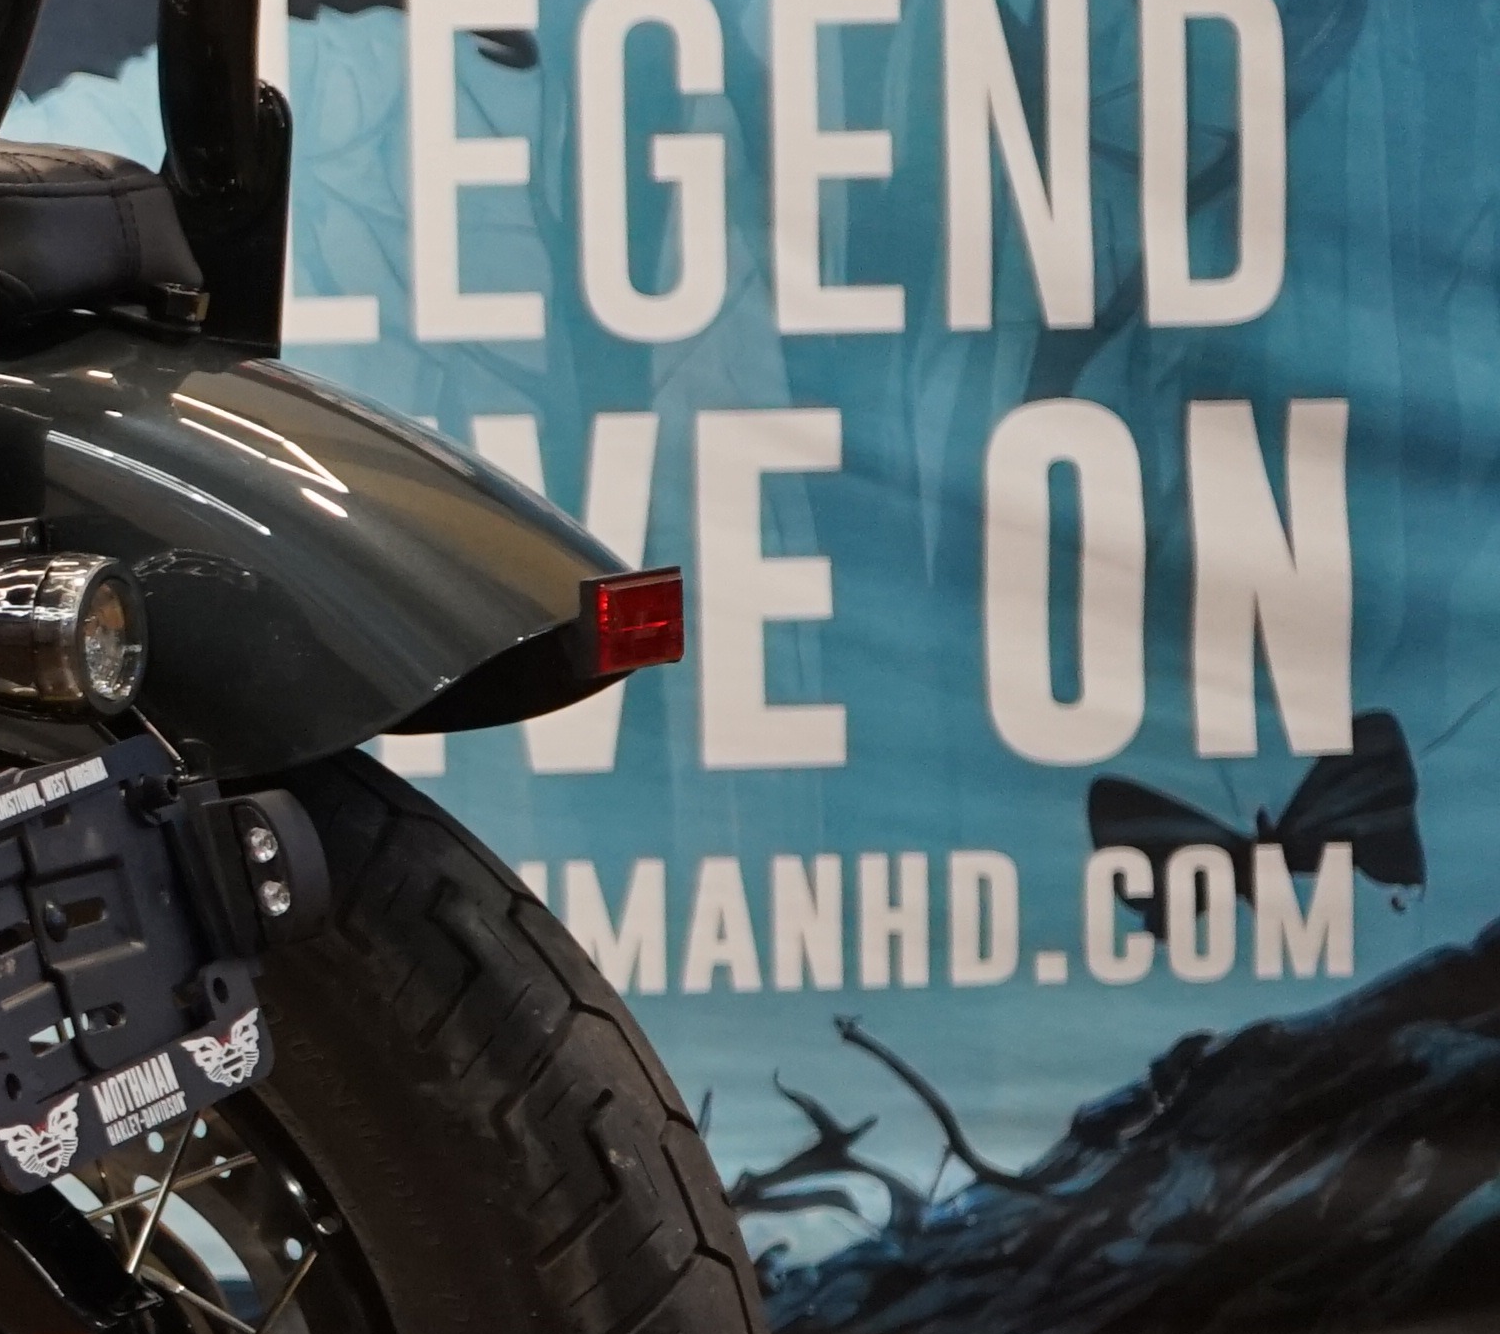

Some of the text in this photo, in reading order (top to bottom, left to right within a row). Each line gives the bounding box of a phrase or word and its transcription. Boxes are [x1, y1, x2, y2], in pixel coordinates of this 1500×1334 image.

[375, 396, 1355, 778] VE ON
[518, 840, 1355, 996] MANHD.COM
[92, 1052, 180, 1124] MOTHMAN
